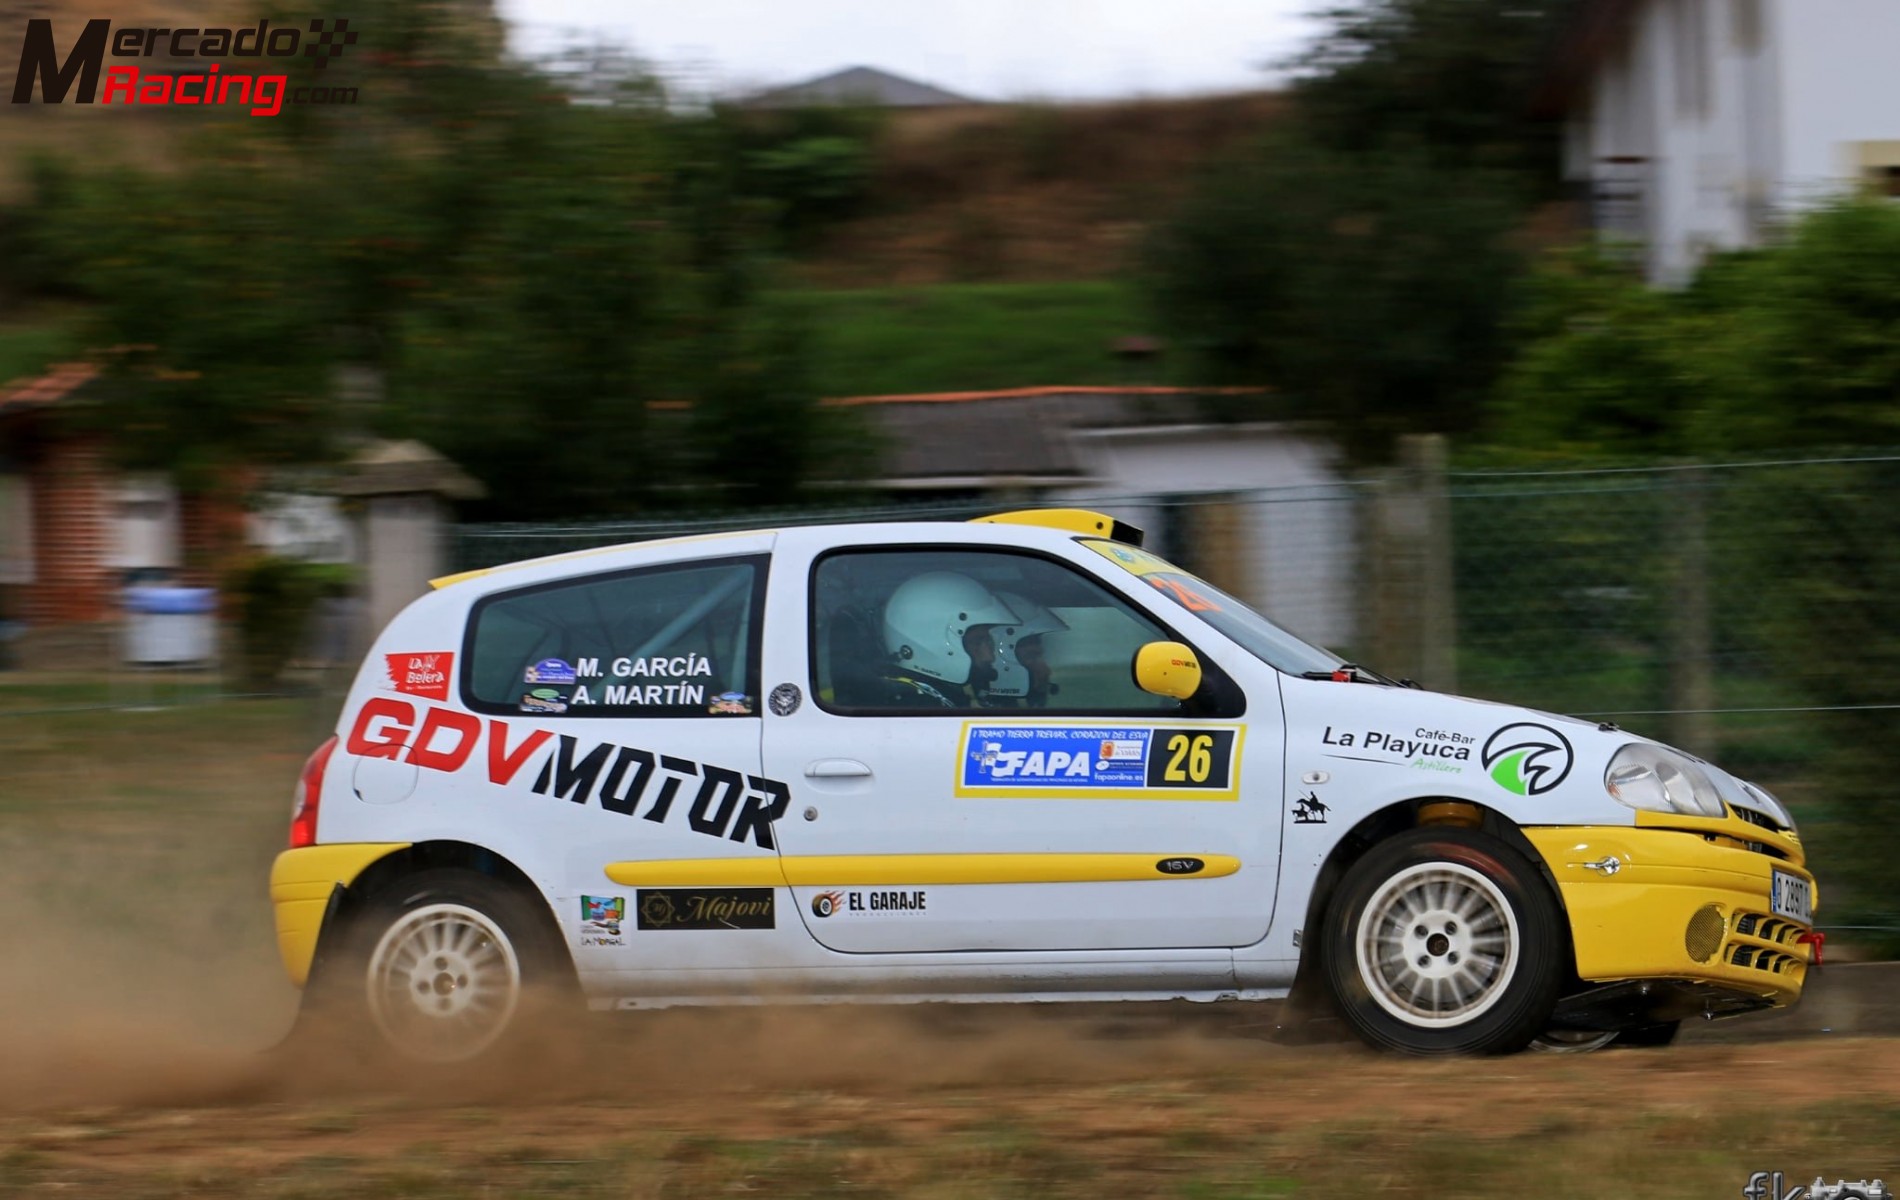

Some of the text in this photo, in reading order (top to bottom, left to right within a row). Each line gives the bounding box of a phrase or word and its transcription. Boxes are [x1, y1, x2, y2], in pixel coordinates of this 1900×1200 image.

[576, 652, 713, 678] M. GARCÍA
[570, 685, 597, 705] A.
[604, 680, 705, 705] MARTÍN
[978, 730, 1005, 739] TRAMO
[1007, 730, 1034, 739] TIERRA
[1112, 731, 1127, 740] DEL
[1322, 726, 1471, 761] La Playuca
[1415, 727, 1476, 745] Café-Bar
[992, 751, 1090, 777] FAPA
[1164, 734, 1213, 783] 26
[1094, 772, 1144, 782] fapaonline.es
[1165, 860, 1195, 871] 16V
[676, 896, 771, 922] Majovi
[849, 891, 926, 911] EL GARAJE
